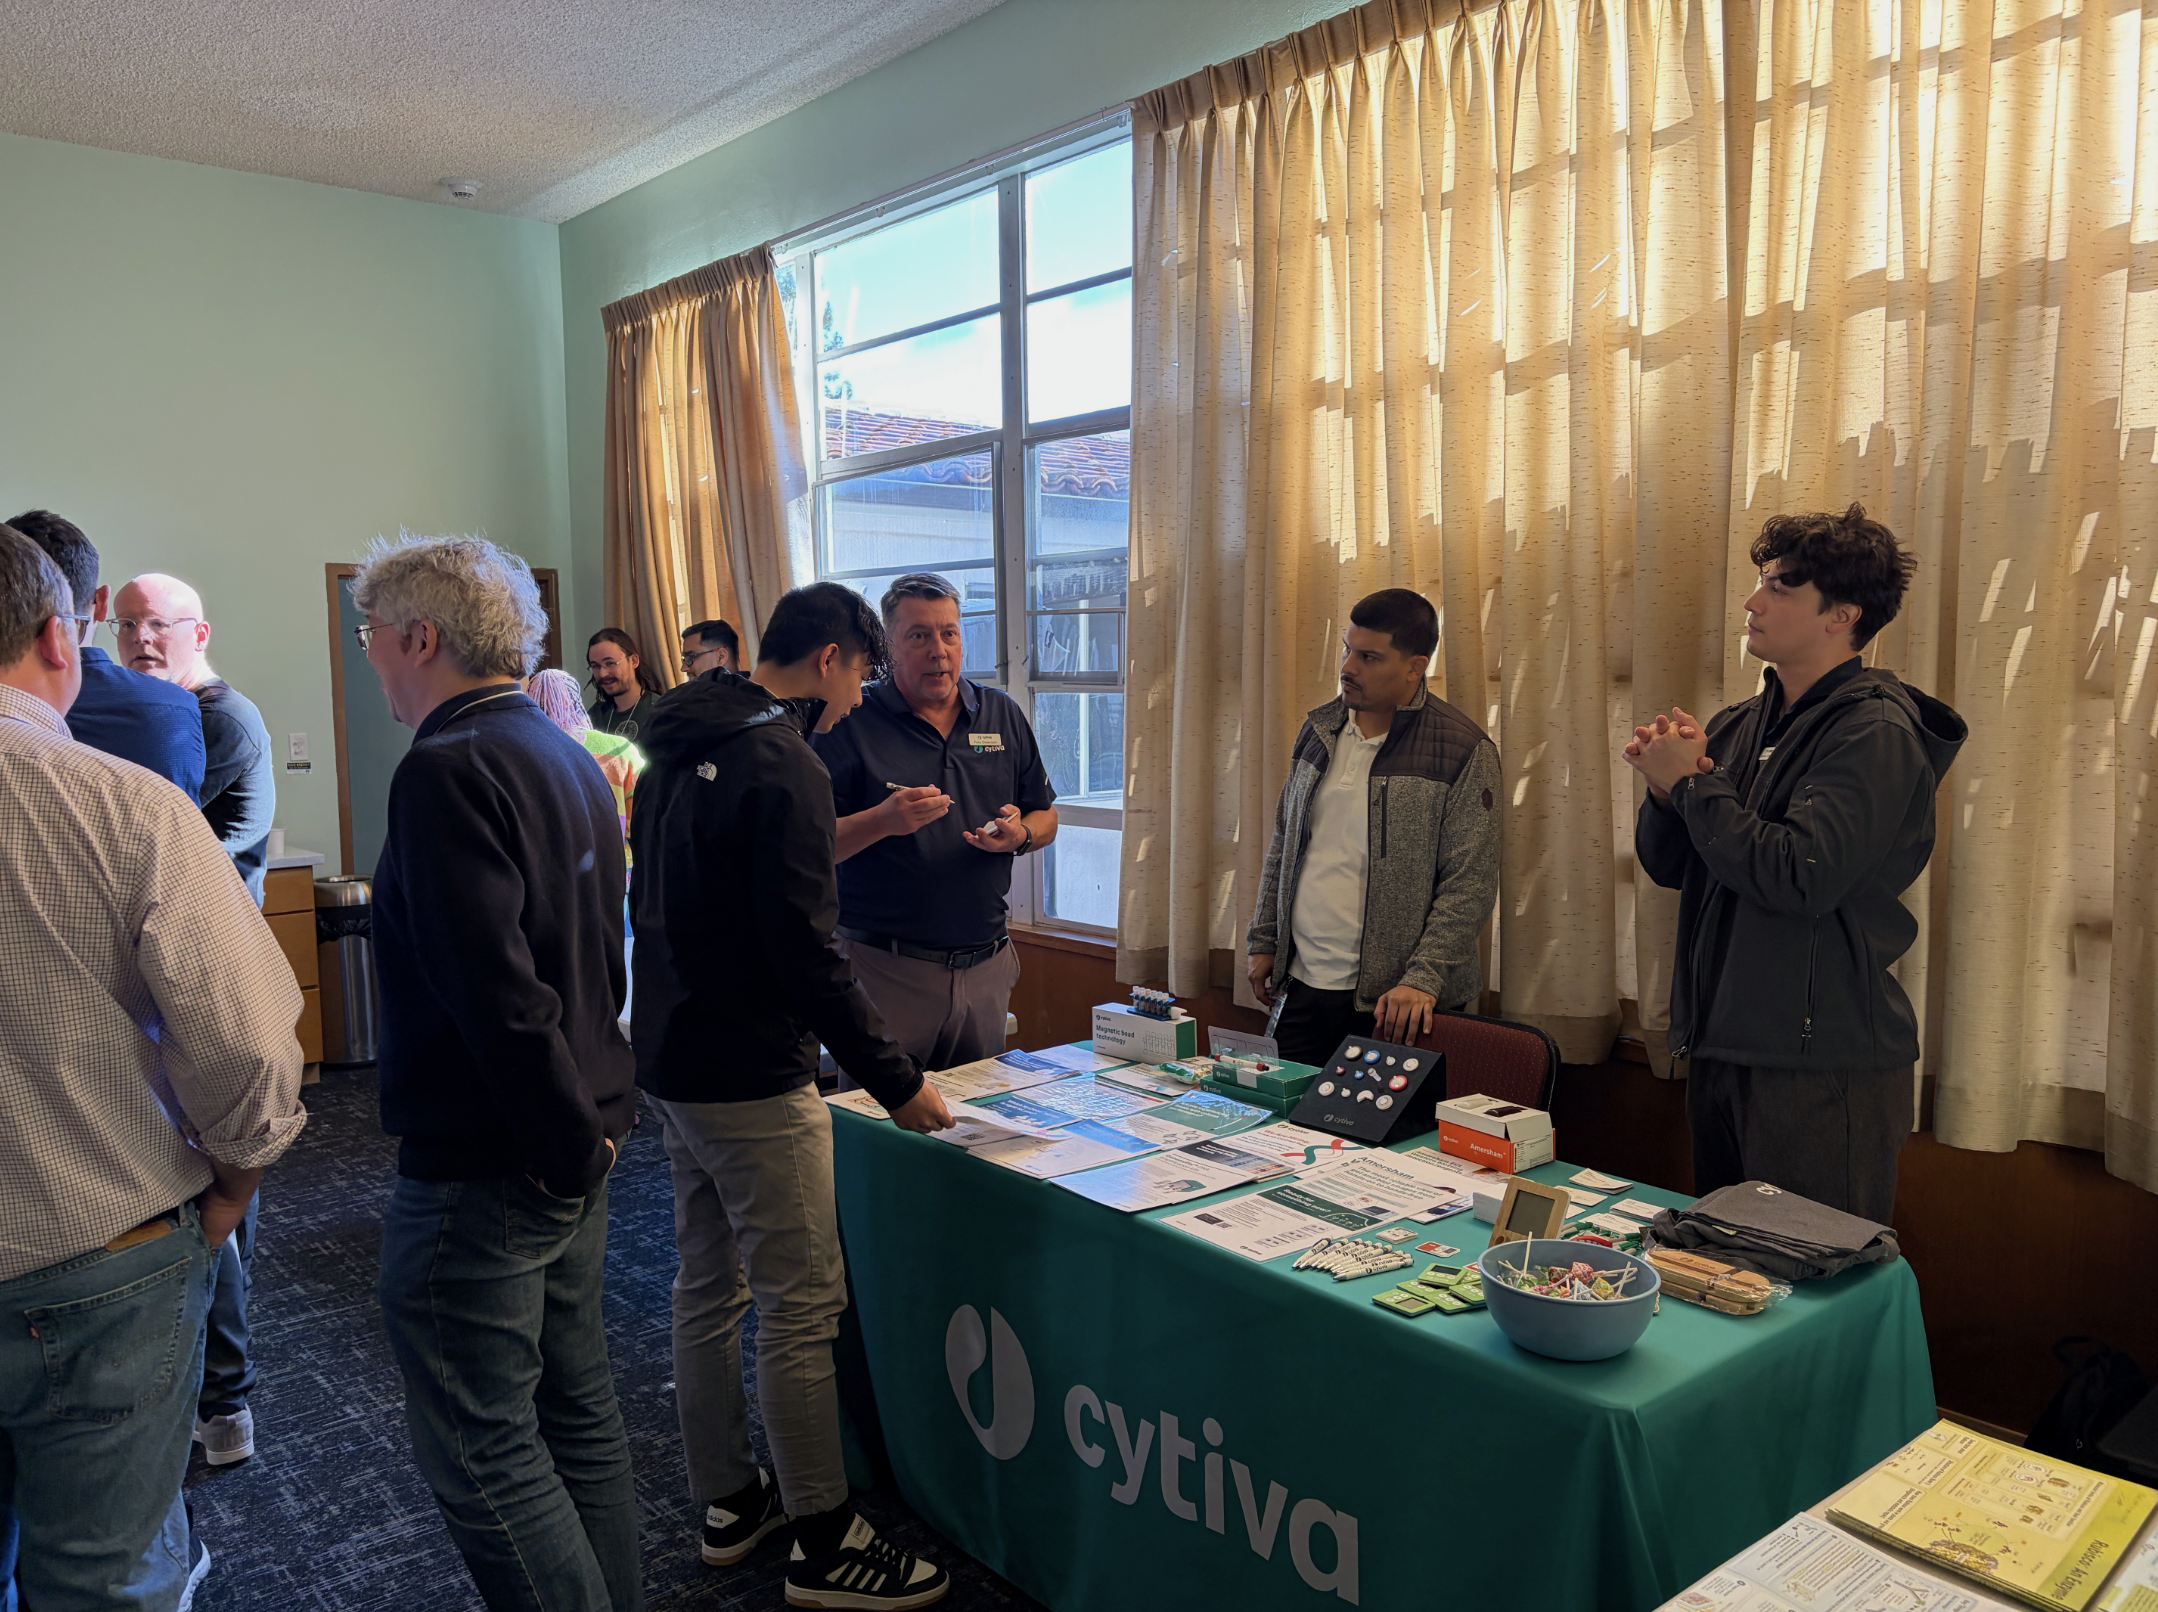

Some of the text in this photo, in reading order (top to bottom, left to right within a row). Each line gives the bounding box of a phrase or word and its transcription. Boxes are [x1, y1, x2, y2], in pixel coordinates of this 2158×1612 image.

[984, 745, 1005, 753] cytiva
[1096, 1024, 1135, 1038] Magnetic bead
[1096, 1033, 1126, 1046] technology
[1334, 1117, 1355, 1126] cytiva
[1358, 1156, 1414, 1180] Amersham
[1064, 1384, 1359, 1606] cytiva
[2051, 1539, 2109, 1600] Rubisco: An Enzyme
